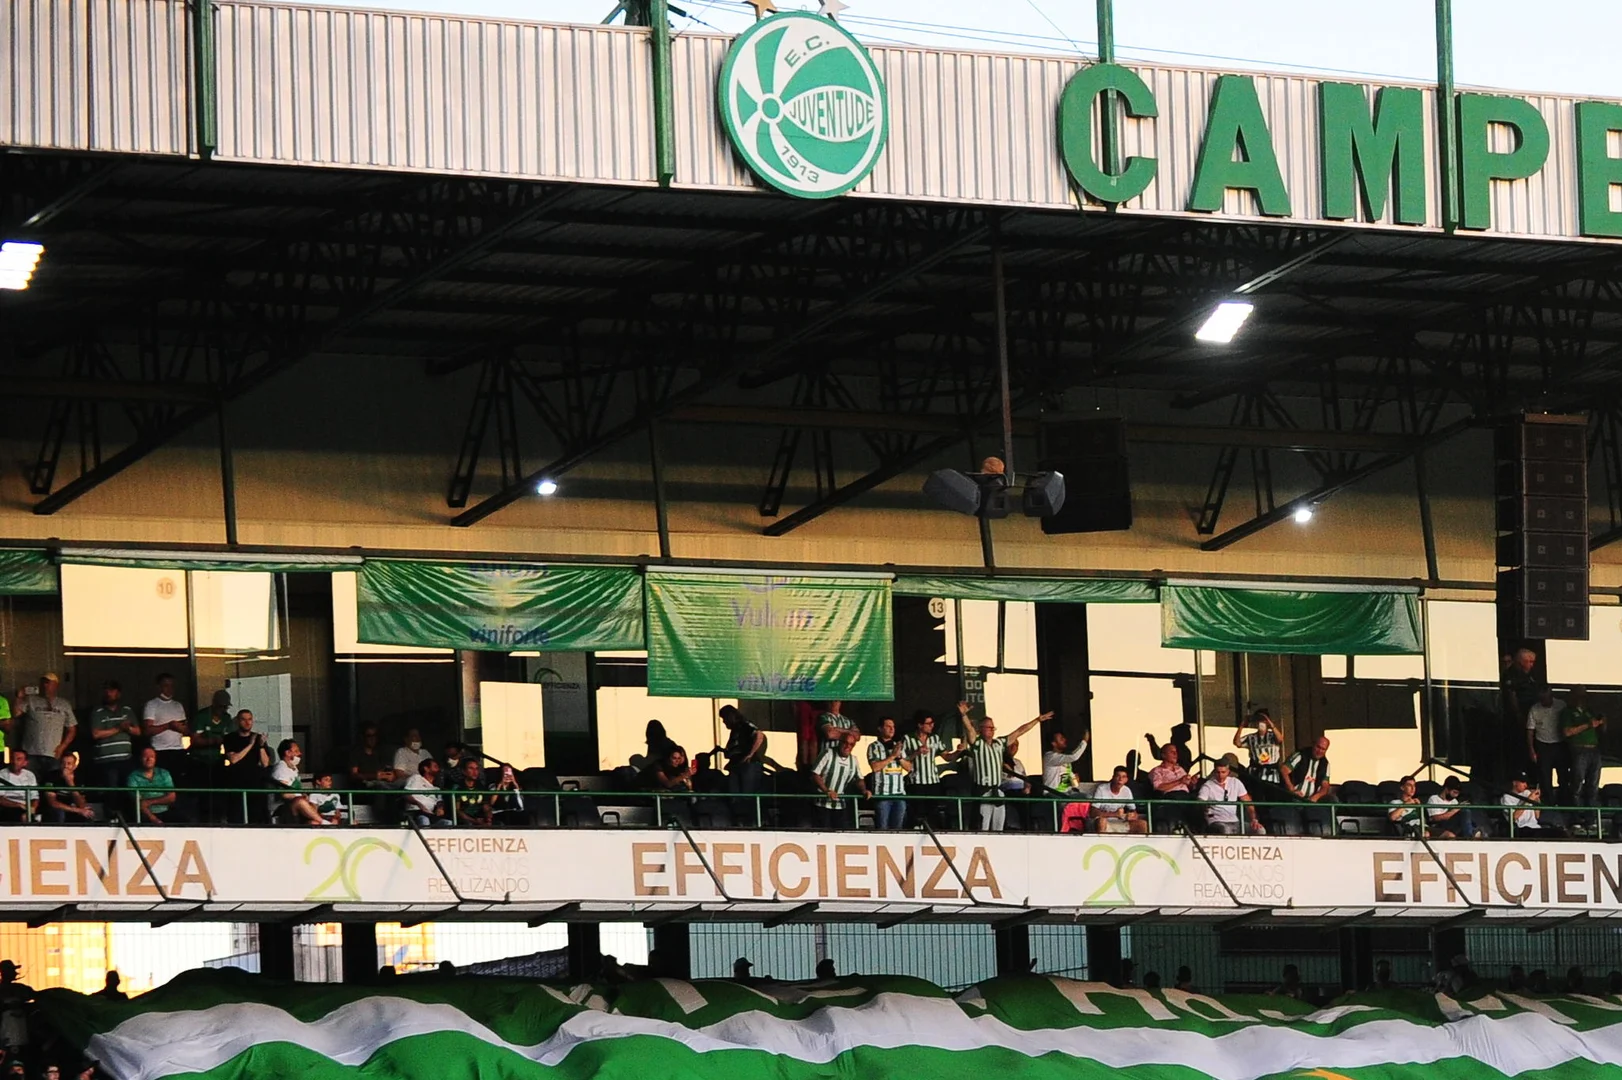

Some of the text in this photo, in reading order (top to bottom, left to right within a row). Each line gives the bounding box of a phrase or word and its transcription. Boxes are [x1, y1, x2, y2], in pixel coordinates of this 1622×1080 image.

[784, 35, 830, 68] E.C.
[789, 90, 875, 138] JUVENTUDE
[782, 145, 820, 184] 1913
[931, 602, 944, 614] 13
[426, 838, 528, 853] EFFICIENZA
[1192, 846, 1283, 861] EFFICIENZA
[0, 838, 218, 896] IENZA
[632, 842, 1002, 898] EFFICIENZA
